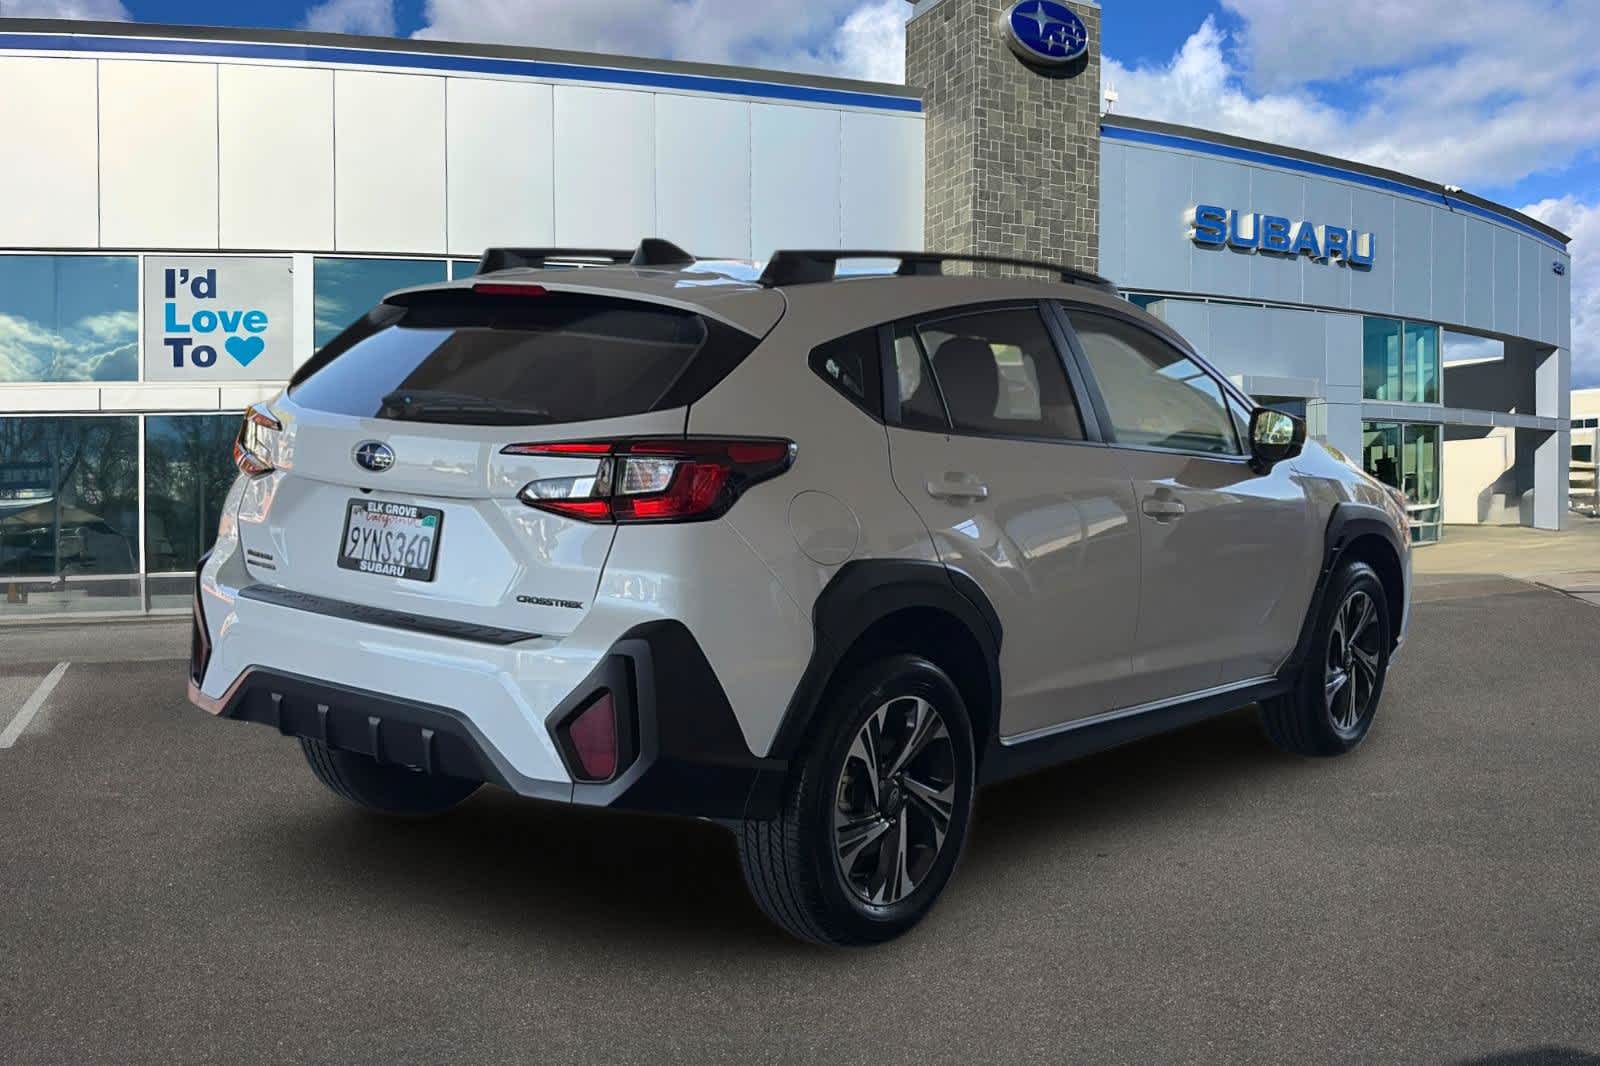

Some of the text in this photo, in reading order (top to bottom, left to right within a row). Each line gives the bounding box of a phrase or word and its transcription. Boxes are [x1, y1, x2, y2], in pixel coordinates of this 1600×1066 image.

[1191, 204, 1376, 272] SUBARU
[165, 269, 216, 299] I’d
[165, 303, 268, 333] Love
[164, 338, 217, 368] To
[367, 501, 383, 513] ELK
[386, 504, 418, 518] GROVE
[346, 526, 431, 568] 9YNS360
[359, 561, 406, 577] SUBARU
[516, 594, 584, 610] CROSSTREK
